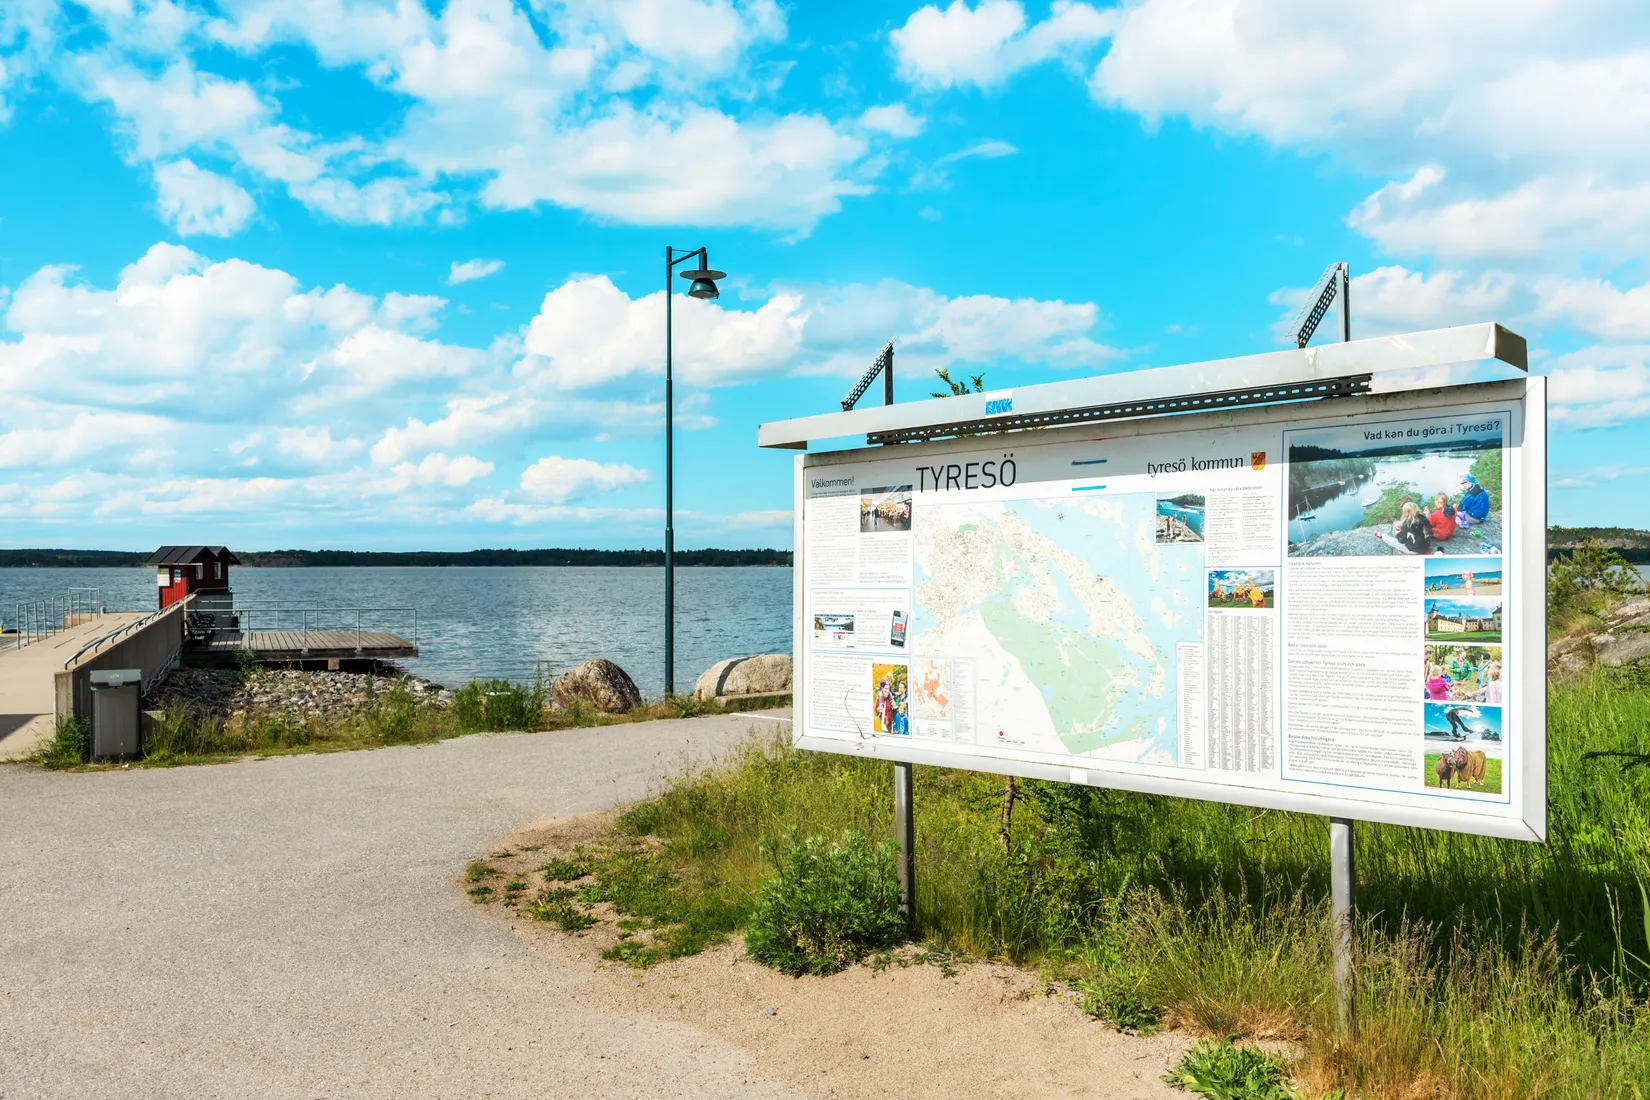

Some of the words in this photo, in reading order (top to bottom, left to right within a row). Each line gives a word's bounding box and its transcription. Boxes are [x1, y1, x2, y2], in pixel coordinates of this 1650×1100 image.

[1364, 431, 1382, 440] Vad
[1384, 430, 1404, 439] kan
[1406, 428, 1420, 437] du
[1422, 426, 1446, 438] göra
[1450, 424, 1453, 434] i
[1456, 420, 1500, 435] Tyresö?
[916, 453, 1017, 493] TYRESÖ
[1147, 459, 1186, 478] tyresö
[1191, 457, 1244, 471] kommun
[811, 476, 855, 488] Välkommen!
